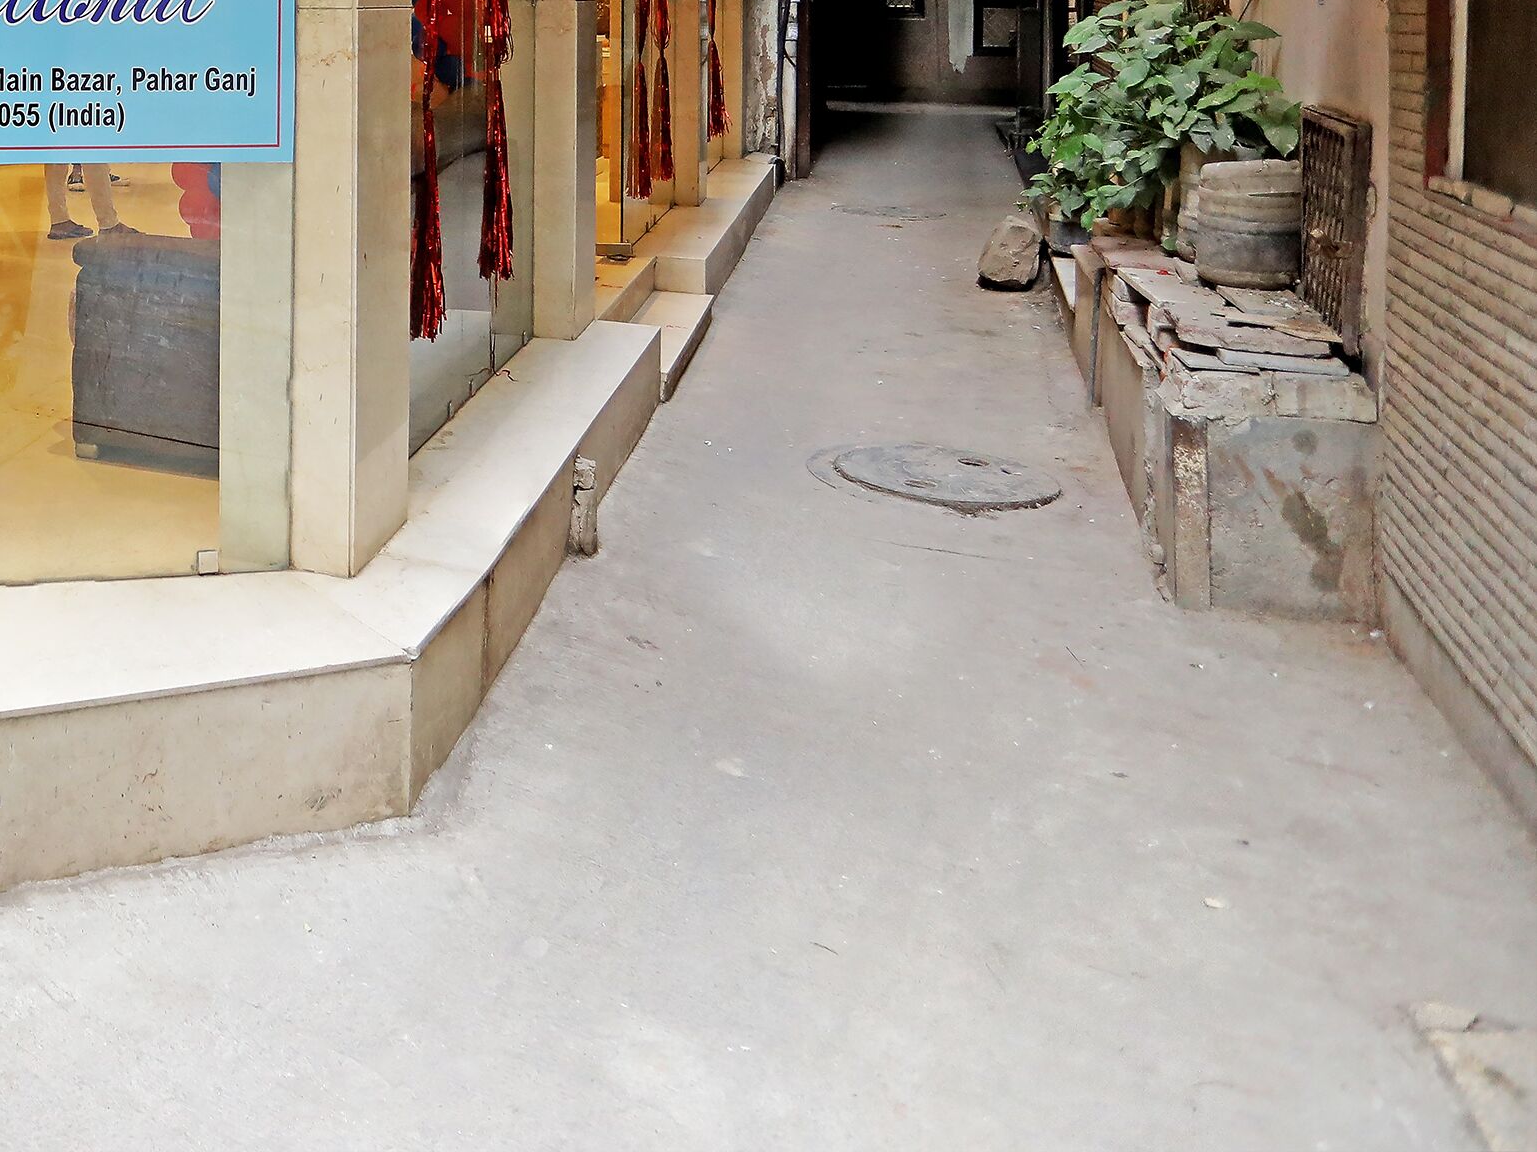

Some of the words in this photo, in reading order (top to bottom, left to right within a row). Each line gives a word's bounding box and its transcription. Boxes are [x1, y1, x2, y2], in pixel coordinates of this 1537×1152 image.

[50, 67, 123, 96] Bazar,
[130, 67, 199, 92] Pahar
[204, 66, 257, 97] Ganj
[48, 102, 126, 133] (India)
